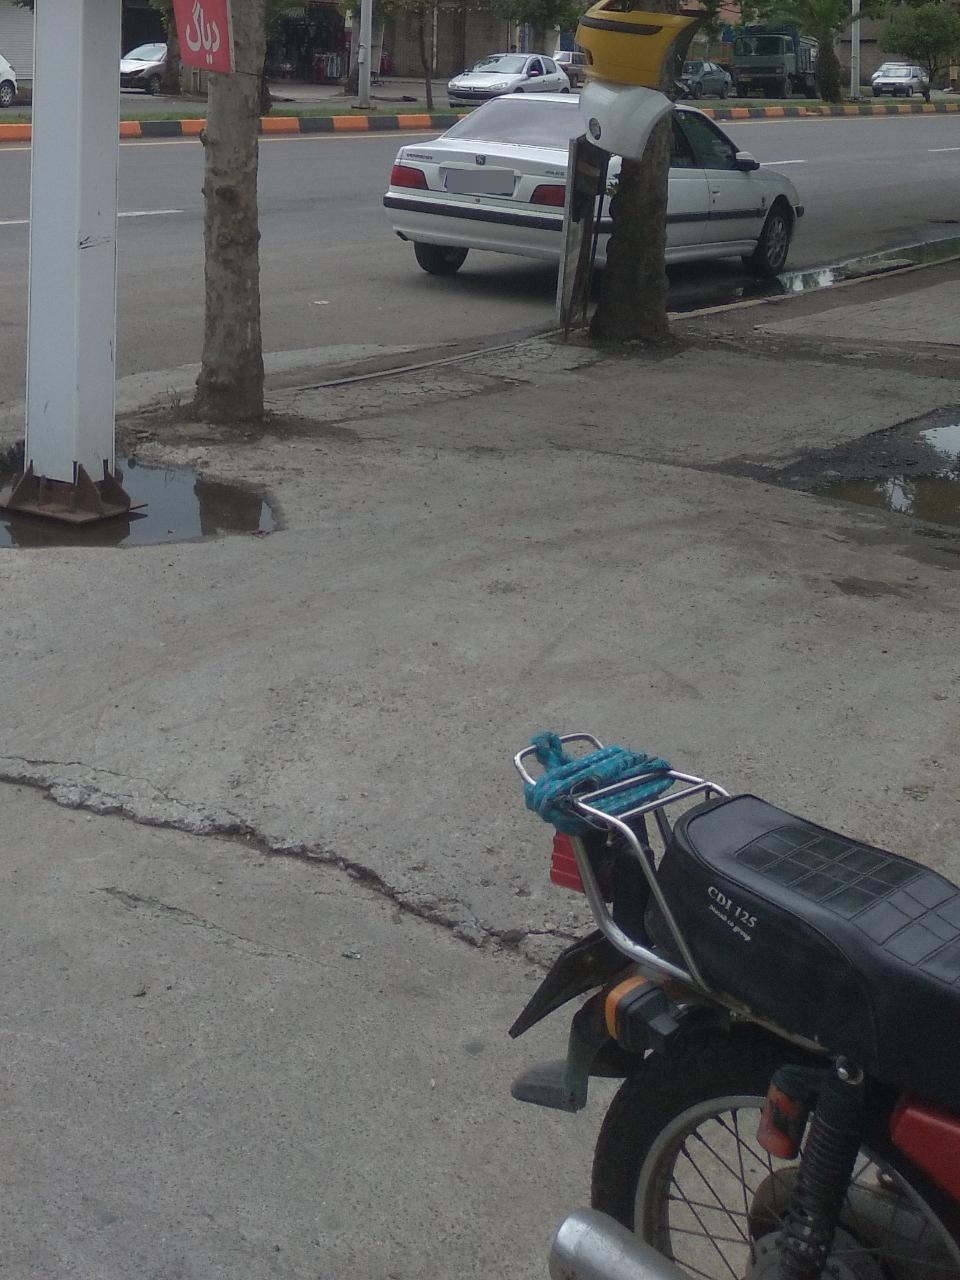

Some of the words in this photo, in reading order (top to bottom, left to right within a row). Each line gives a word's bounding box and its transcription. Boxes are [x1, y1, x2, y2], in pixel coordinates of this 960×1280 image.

[185, 0, 220, 65] دیاگ
[707, 886, 732, 910] CDI
[734, 906, 758, 928] 125
